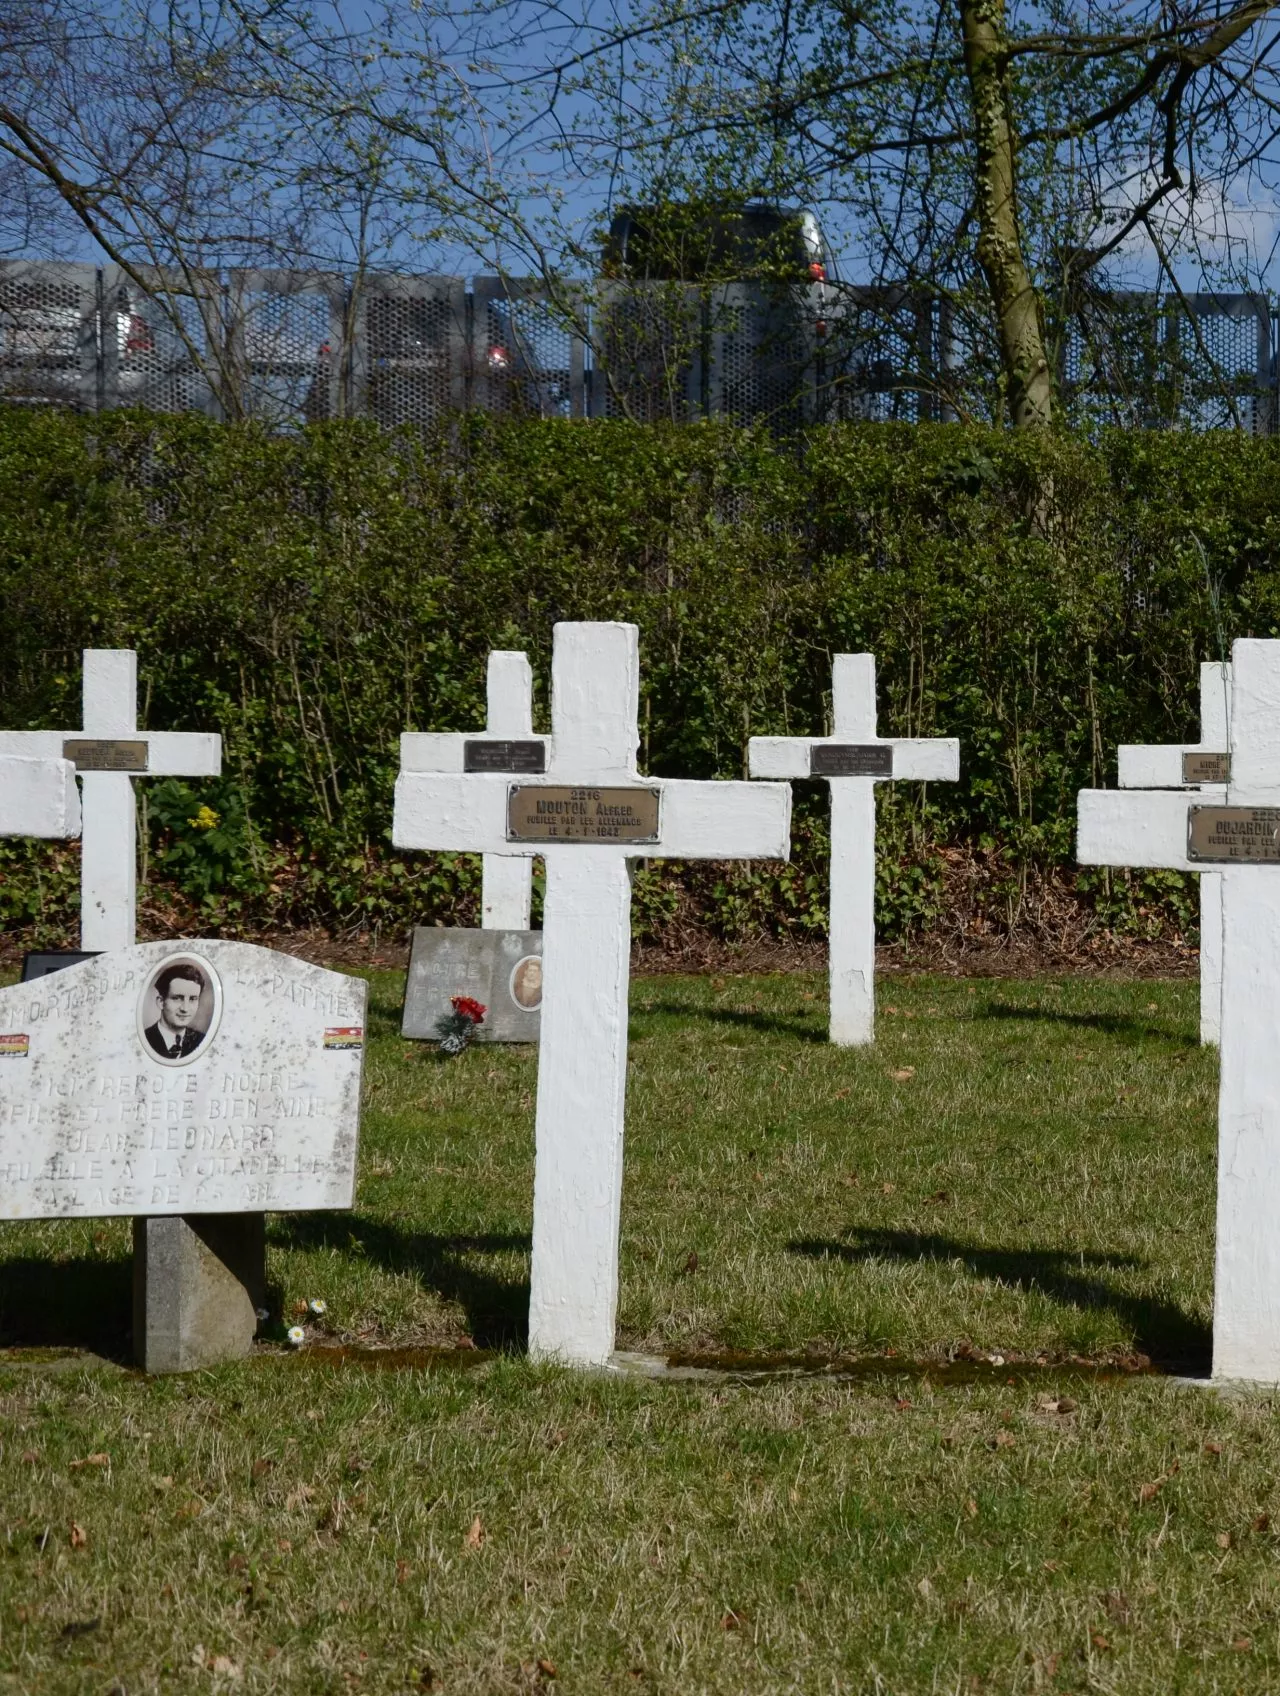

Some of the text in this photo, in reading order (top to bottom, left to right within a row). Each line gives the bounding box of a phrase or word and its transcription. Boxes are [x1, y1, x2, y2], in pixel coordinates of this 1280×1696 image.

[536, 800, 587, 814] MOUTON
[1216, 821, 1276, 836] DUJARDIN
[222, 1072, 298, 1093] NOTRE
[152, 1185, 180, 1204] DE
